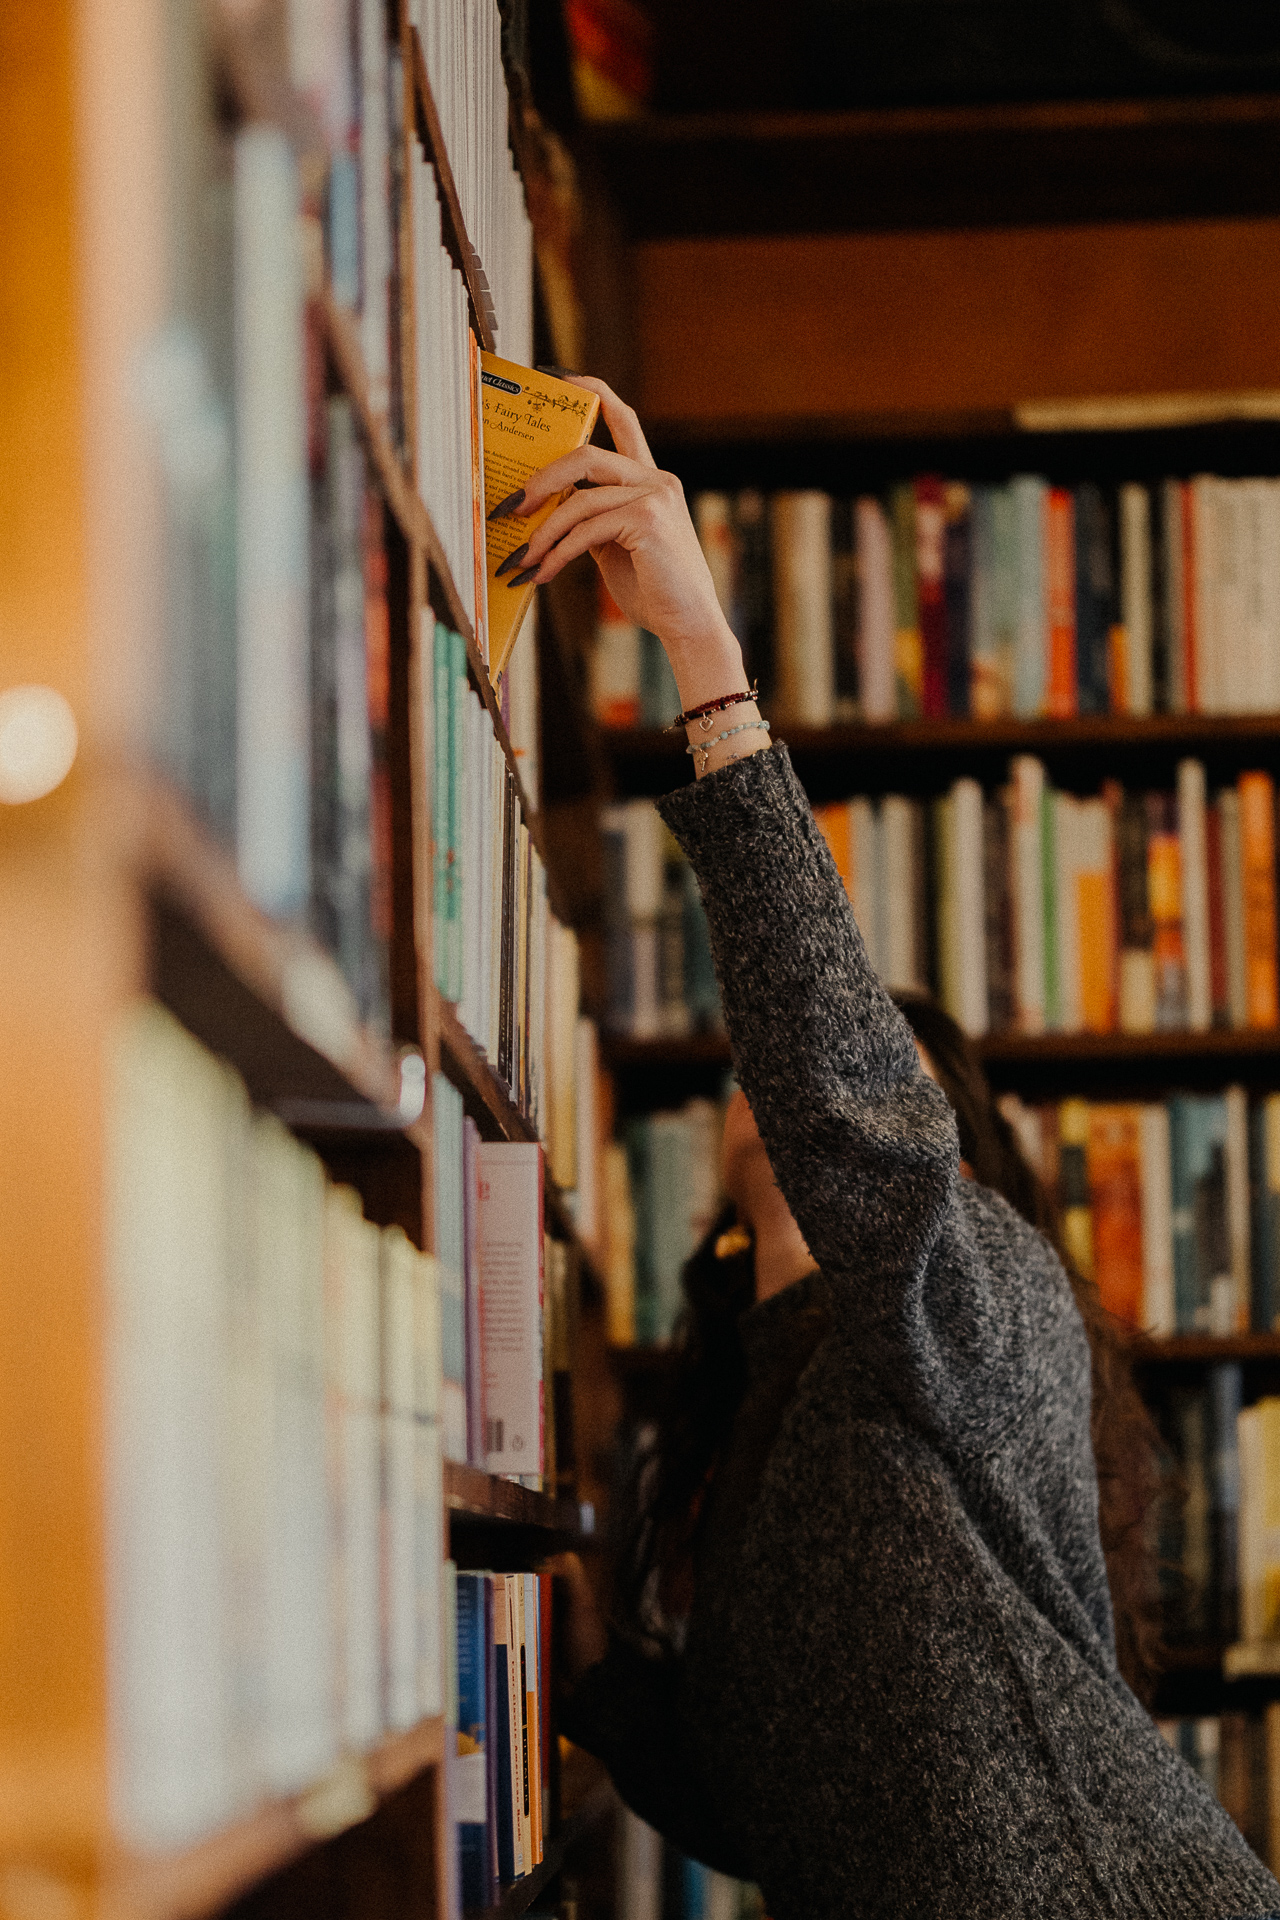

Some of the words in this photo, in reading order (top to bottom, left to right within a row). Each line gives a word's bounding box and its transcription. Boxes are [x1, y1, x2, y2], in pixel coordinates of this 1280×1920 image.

[492, 378, 520, 393] Classics
[482, 399, 491, 411] 's
[493, 403, 522, 424] Fairy
[524, 413, 551, 432] Tales
[482, 418, 490, 426] n
[489, 420, 535, 442] Andersen
[517, 460, 536, 471] beloved
[509, 532, 523, 541] Little
